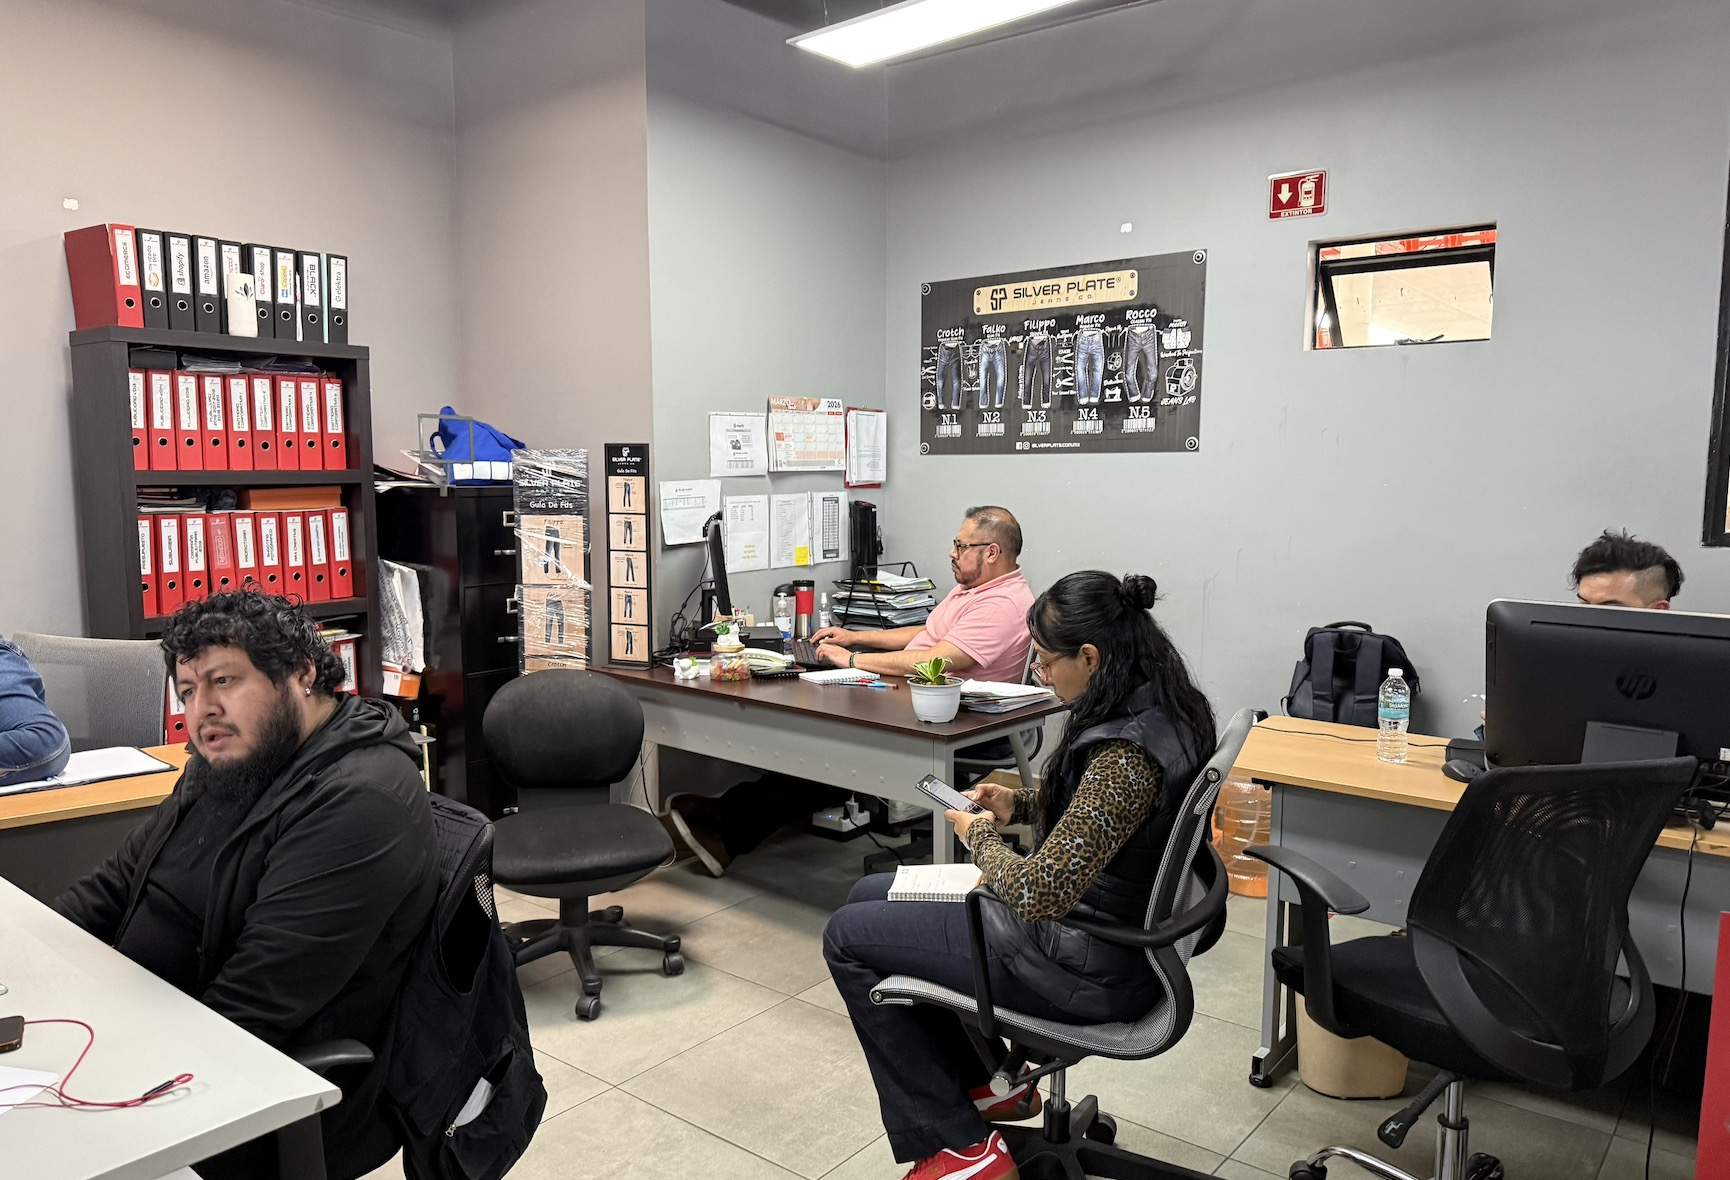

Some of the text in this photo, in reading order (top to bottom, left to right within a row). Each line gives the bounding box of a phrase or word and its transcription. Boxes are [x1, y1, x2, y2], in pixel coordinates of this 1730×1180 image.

[1280, 208, 1313, 217] EXTINTOR
[176, 252, 184, 277] shopify
[1013, 284, 1061, 299] SILVER
[1032, 296, 1070, 305] JEANS
[1075, 313, 1106, 325] Marco
[936, 327, 965, 338] Crotch
[982, 324, 1006, 335] Falko
[770, 398, 842, 409] MARZO 2026
[529, 500, 574, 509] Guía De Fits
